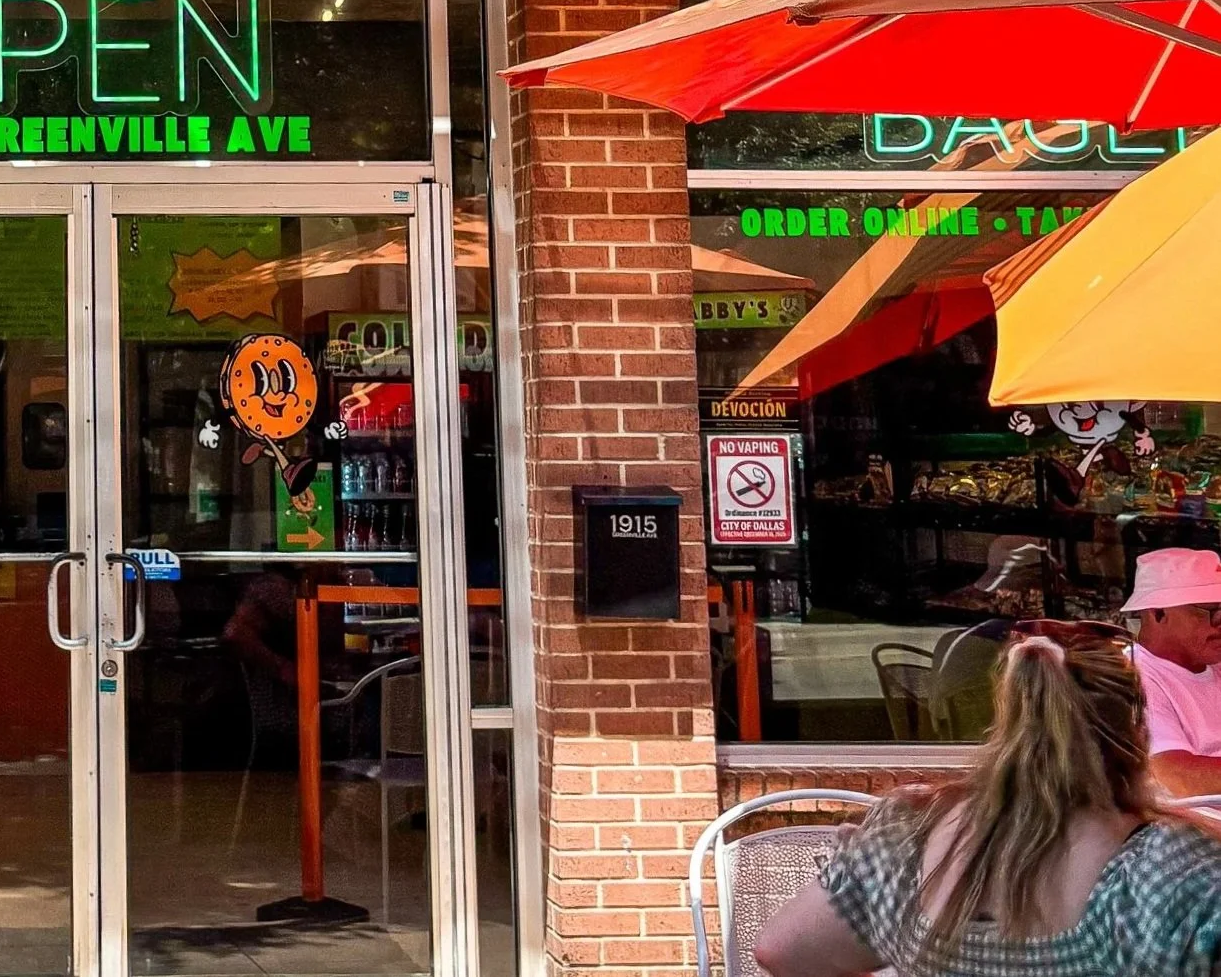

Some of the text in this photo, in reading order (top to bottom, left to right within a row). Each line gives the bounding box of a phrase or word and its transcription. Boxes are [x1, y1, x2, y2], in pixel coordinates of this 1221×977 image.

[226, 116, 312, 154] AVE
[741, 207, 850, 237] ORDER
[863, 206, 979, 236] ONLINE
[694, 300, 768, 320] BBY'S
[711, 399, 786, 418] DEVOCIÓN
[719, 441, 779, 454] NO VAPING
[609, 514, 658, 533] 1915
[720, 521, 785, 531] CITY OF DALLAS
[131, 552, 175, 564] PULL
